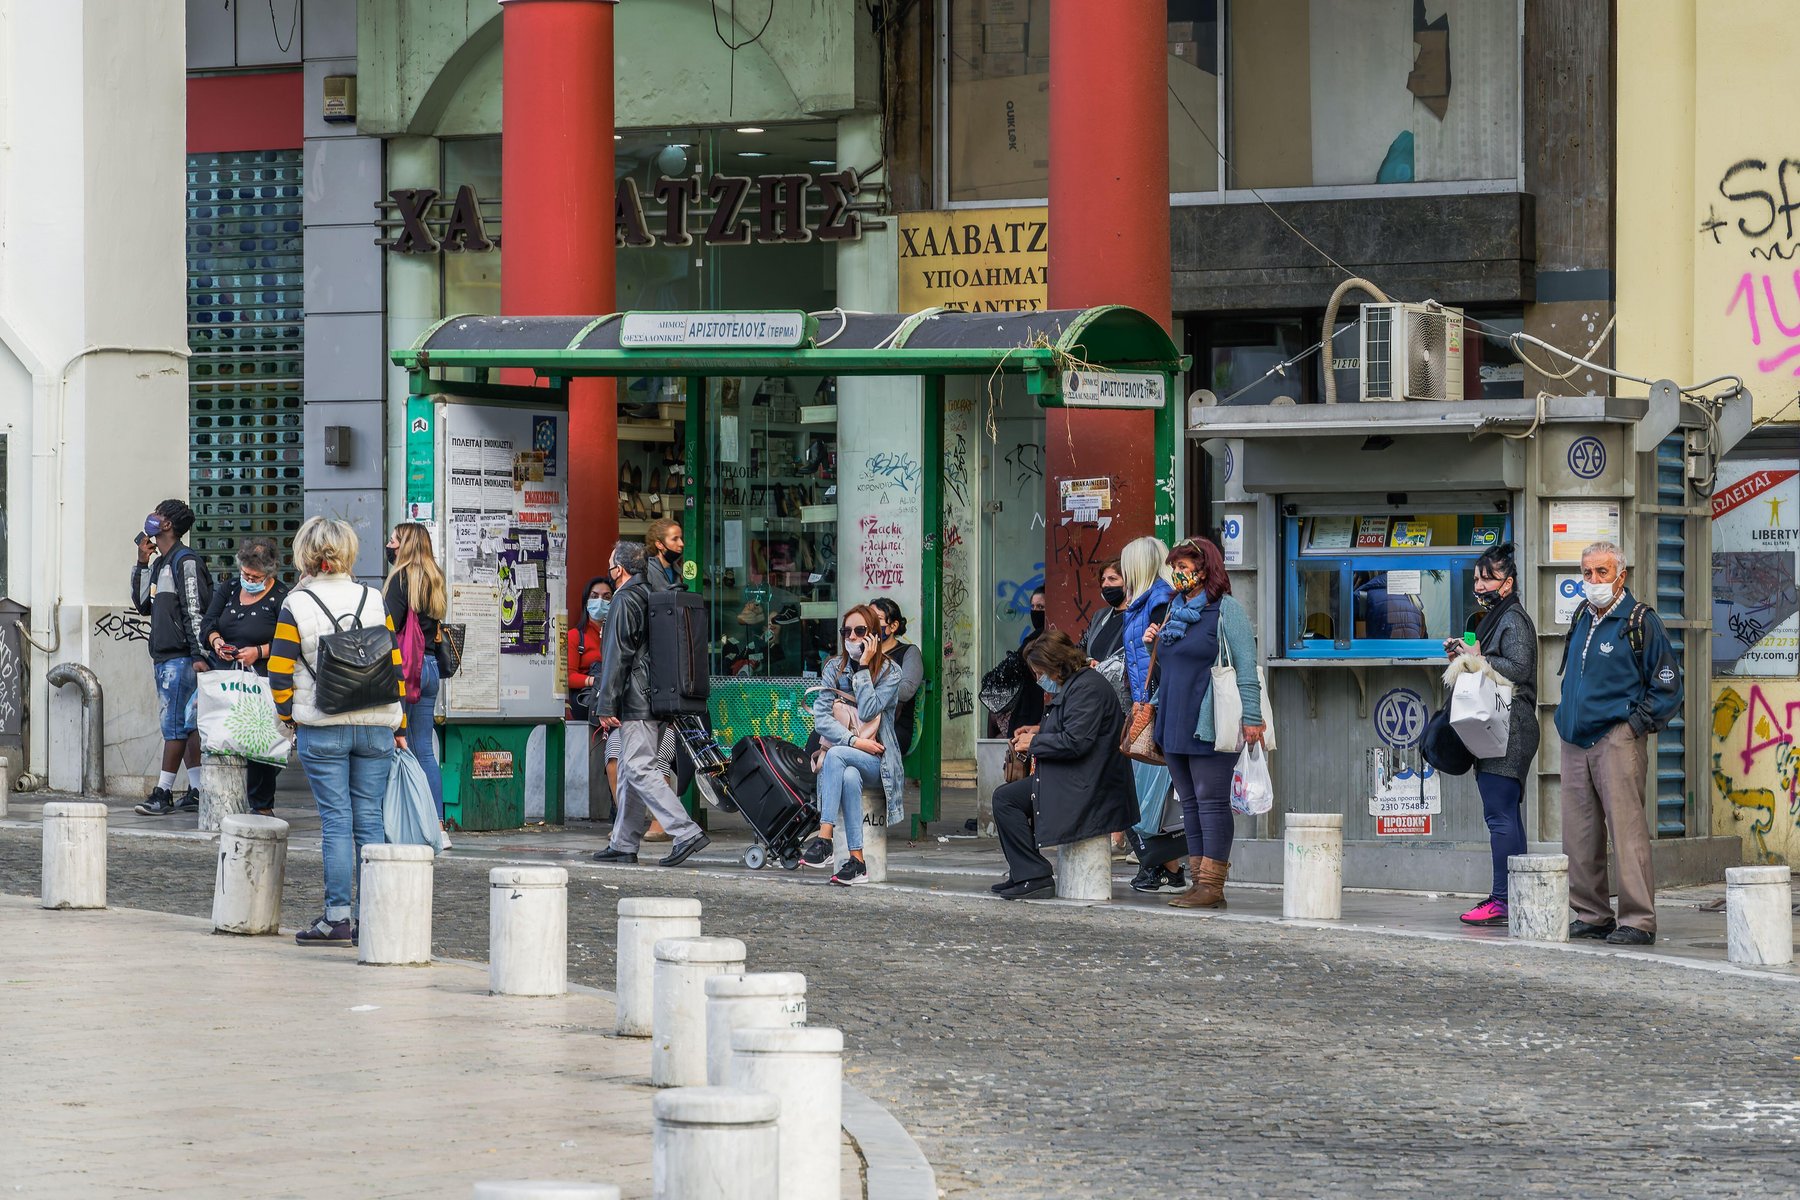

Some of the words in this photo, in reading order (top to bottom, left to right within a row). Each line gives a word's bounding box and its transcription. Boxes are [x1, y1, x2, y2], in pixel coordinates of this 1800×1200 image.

[657, 321, 686, 330] ΔΗΜΟΣ
[688, 322, 766, 338] ΑΡΙΣΤΟΤΕΛΟΥΣ
[767, 324, 798, 338] (ΤΕΡΜΑ)
[623, 333, 684, 342] ΘΕΣΣΑΛΟΝΙΚΗΣ
[1101, 380, 1143, 398] ΑΡΙΣΤΟΤΕΛΟΥΣ
[1360, 535, 1377, 544] 2,00
[1752, 529, 1799, 541] LIBERTY
[1381, 803, 1399, 811] 2310
[1383, 816, 1426, 828] ΠΡΟΣΟΧΗ
